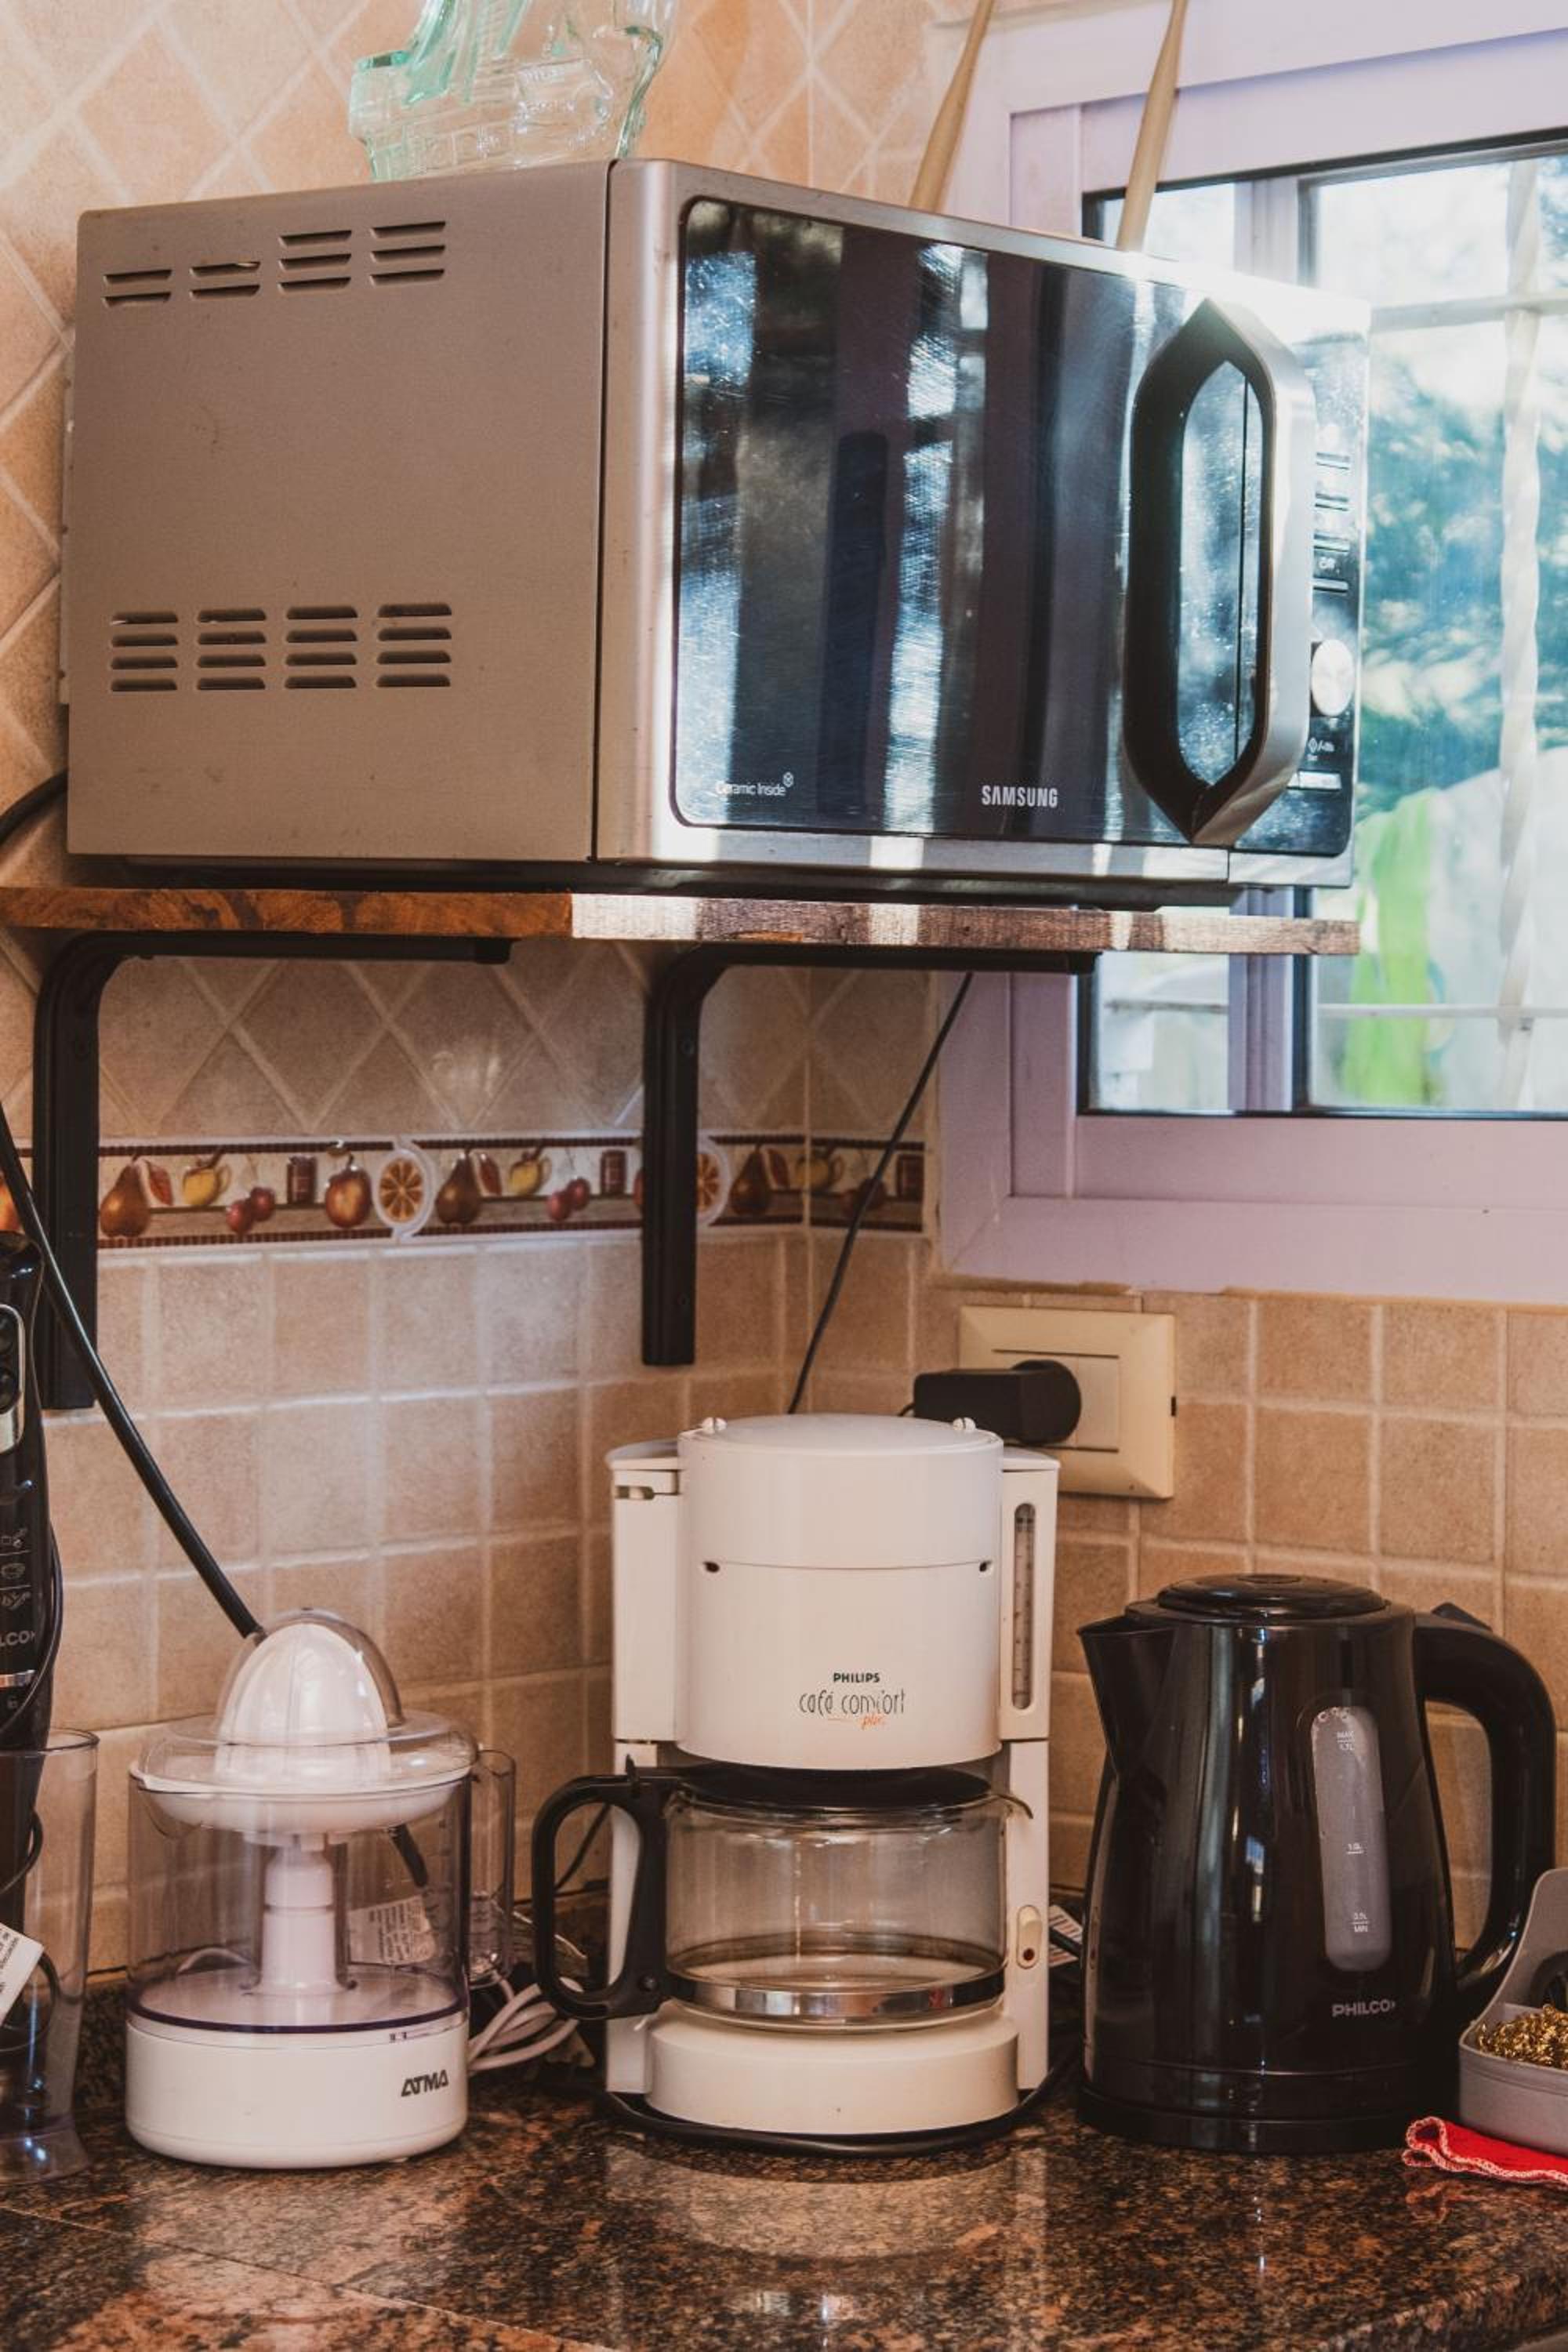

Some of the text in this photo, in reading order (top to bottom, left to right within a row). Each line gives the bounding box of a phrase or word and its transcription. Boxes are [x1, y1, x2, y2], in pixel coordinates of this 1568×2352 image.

[757, 782, 786, 796] Inside
[982, 785, 1058, 808] SAMSUNG
[833, 1672, 880, 1683] PHILIPS
[1332, 1998, 1392, 2017] PHILCO
[401, 2069, 449, 2096] ATMA
